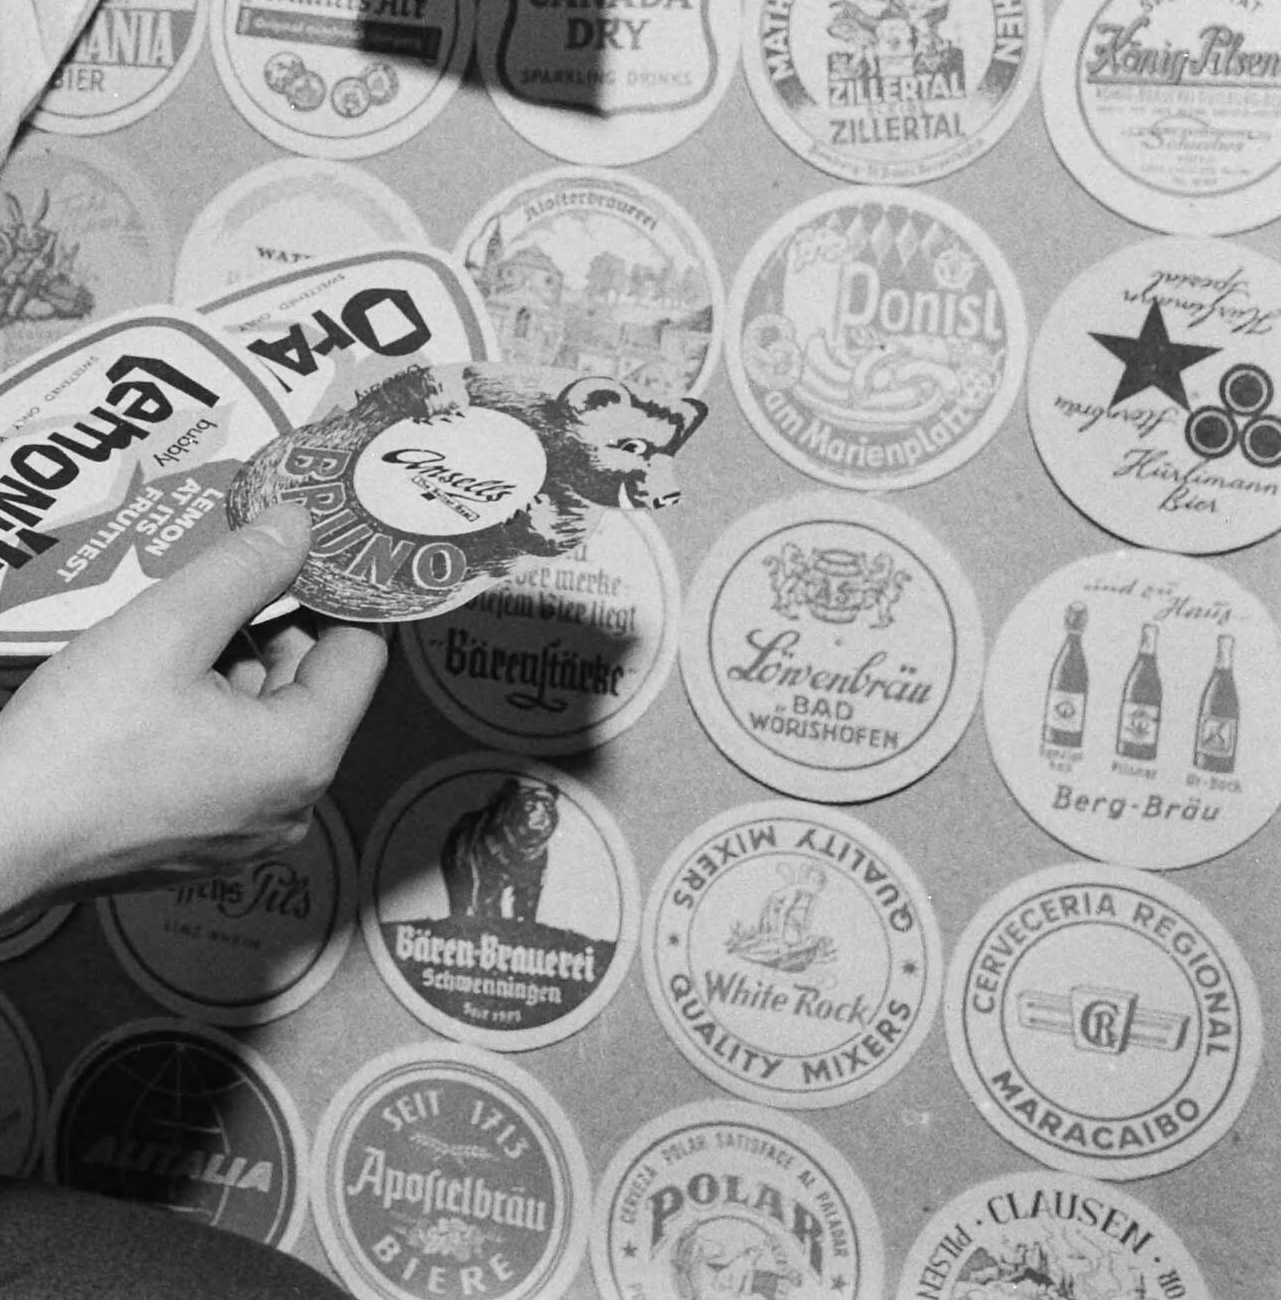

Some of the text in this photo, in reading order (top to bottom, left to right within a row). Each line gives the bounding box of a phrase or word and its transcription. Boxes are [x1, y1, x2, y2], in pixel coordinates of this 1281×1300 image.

[565, 15, 652, 51] DRY
[828, 71, 967, 106] ZILLERTAL
[828, 111, 967, 146] ZILLERTAL
[153, 417, 219, 468] bubbly
[135, 476, 202, 537] AT ITS
[144, 485, 226, 558] LEMON
[1158, 485, 1218, 515] Bier
[56, 484, 165, 584] FRUITIEST
[726, 628, 934, 705] Löwenbräu
[792, 695, 854, 722] BAD
[1052, 784, 1221, 822] Berg-Bräu
[672, 824, 914, 923] QUALITY MIXERS
[394, 925, 597, 983] Bären-Brauerei
[972, 892, 1232, 1057] CERVECERIA REGIONAL
[422, 967, 563, 1006] Schwenningen
[704, 971, 867, 1025] White Rock
[669, 974, 912, 1085] QUALITY MIXERS
[379, 1090, 530, 1159] SEIT 1713
[991, 1069, 1200, 1150] MARACAIBO
[346, 1146, 547, 1232] Apostelbräu
[647, 1173, 824, 1282] POLAR
[986, 1189, 1156, 1255] CLAUSEN
[372, 1234, 515, 1295] BIERE
